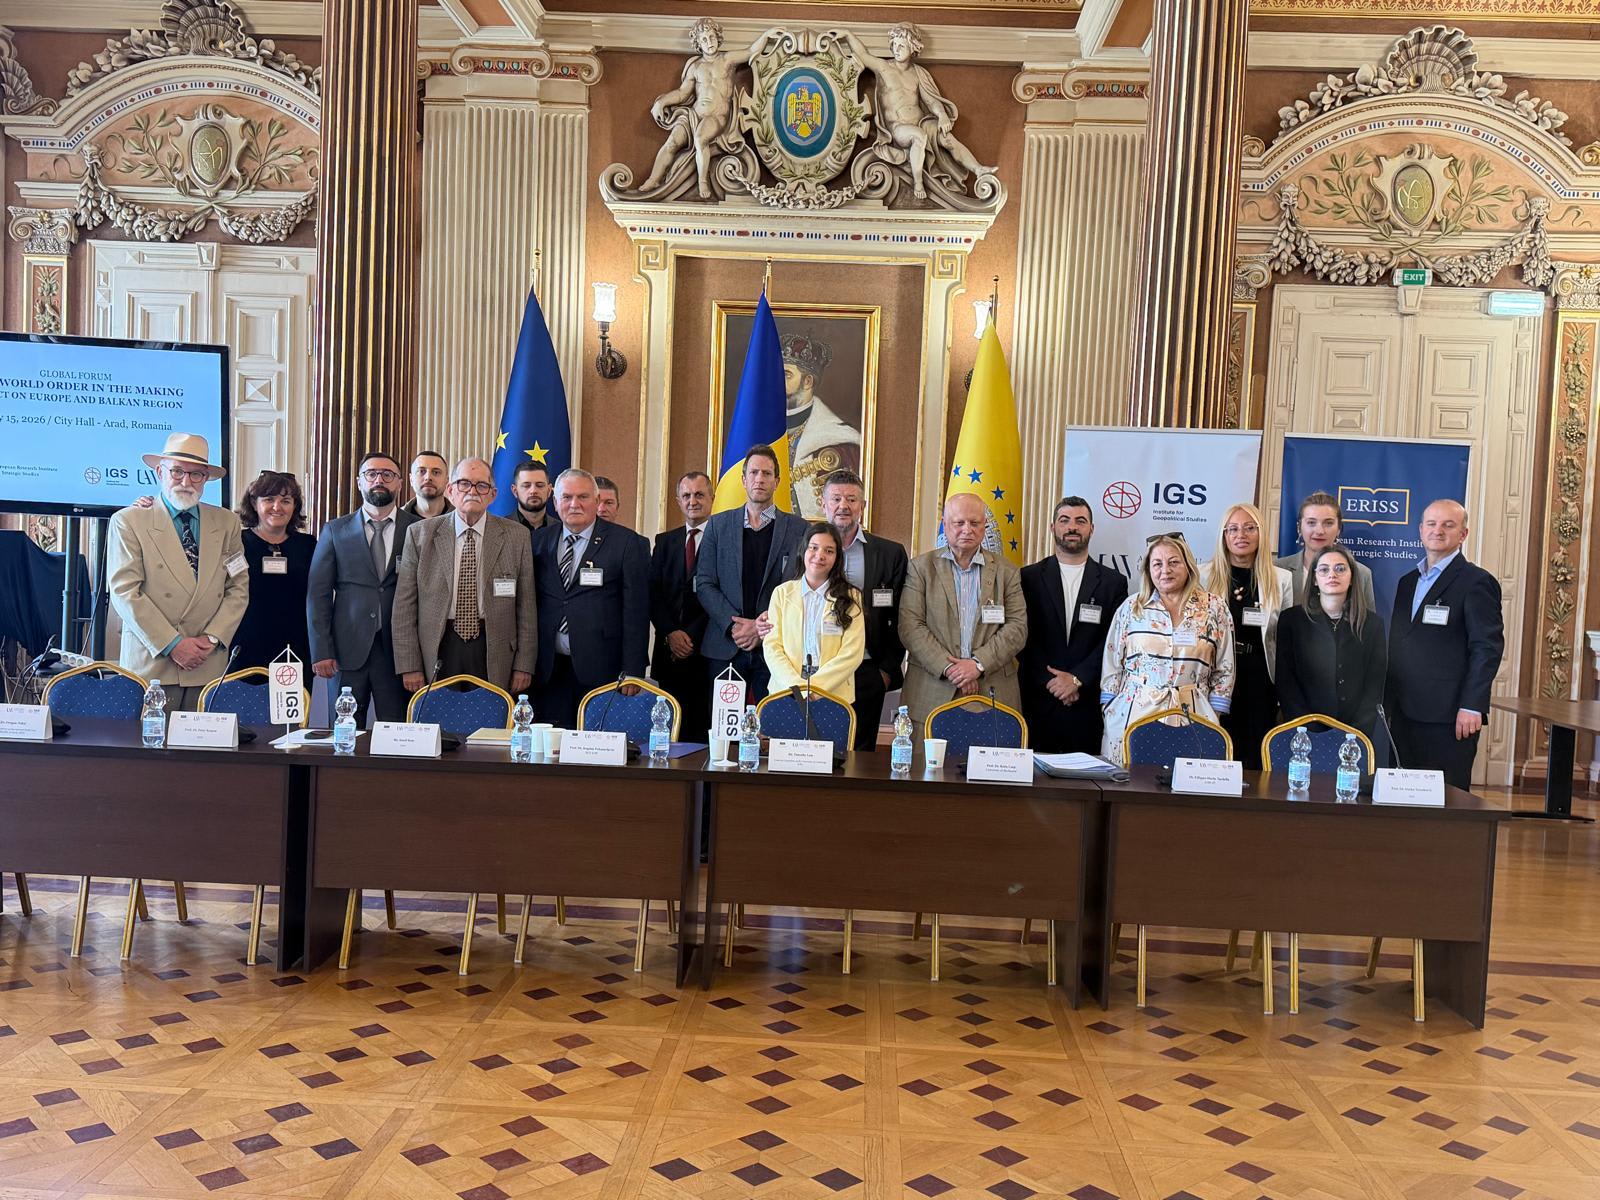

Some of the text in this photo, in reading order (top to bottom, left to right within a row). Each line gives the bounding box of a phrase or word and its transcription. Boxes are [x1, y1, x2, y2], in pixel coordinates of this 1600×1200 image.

[40, 369, 112, 380] GLOBAL FORUM
[0, 378, 184, 397] WORLD ORDER IN THE MAKING
[29, 392, 72, 402] EUROPE
[74, 395, 96, 404] AND
[98, 397, 140, 406] BALKAN
[143, 399, 183, 408] REGION
[6, 415, 19, 423] 15,
[21, 415, 46, 423] 2026
[54, 416, 73, 427] City
[75, 417, 95, 426] Hall
[104, 419, 129, 429] Arad,
[131, 420, 172, 430] Romania
[105, 468, 129, 479] IGS
[1153, 483, 1207, 506] IGS
[1346, 498, 1399, 514] ERISS
[1357, 537, 1397, 547] Research
[1349, 549, 1418, 559] trategic Studies
[285, 691, 299, 719] IGS
[726, 708, 739, 737] IGS
